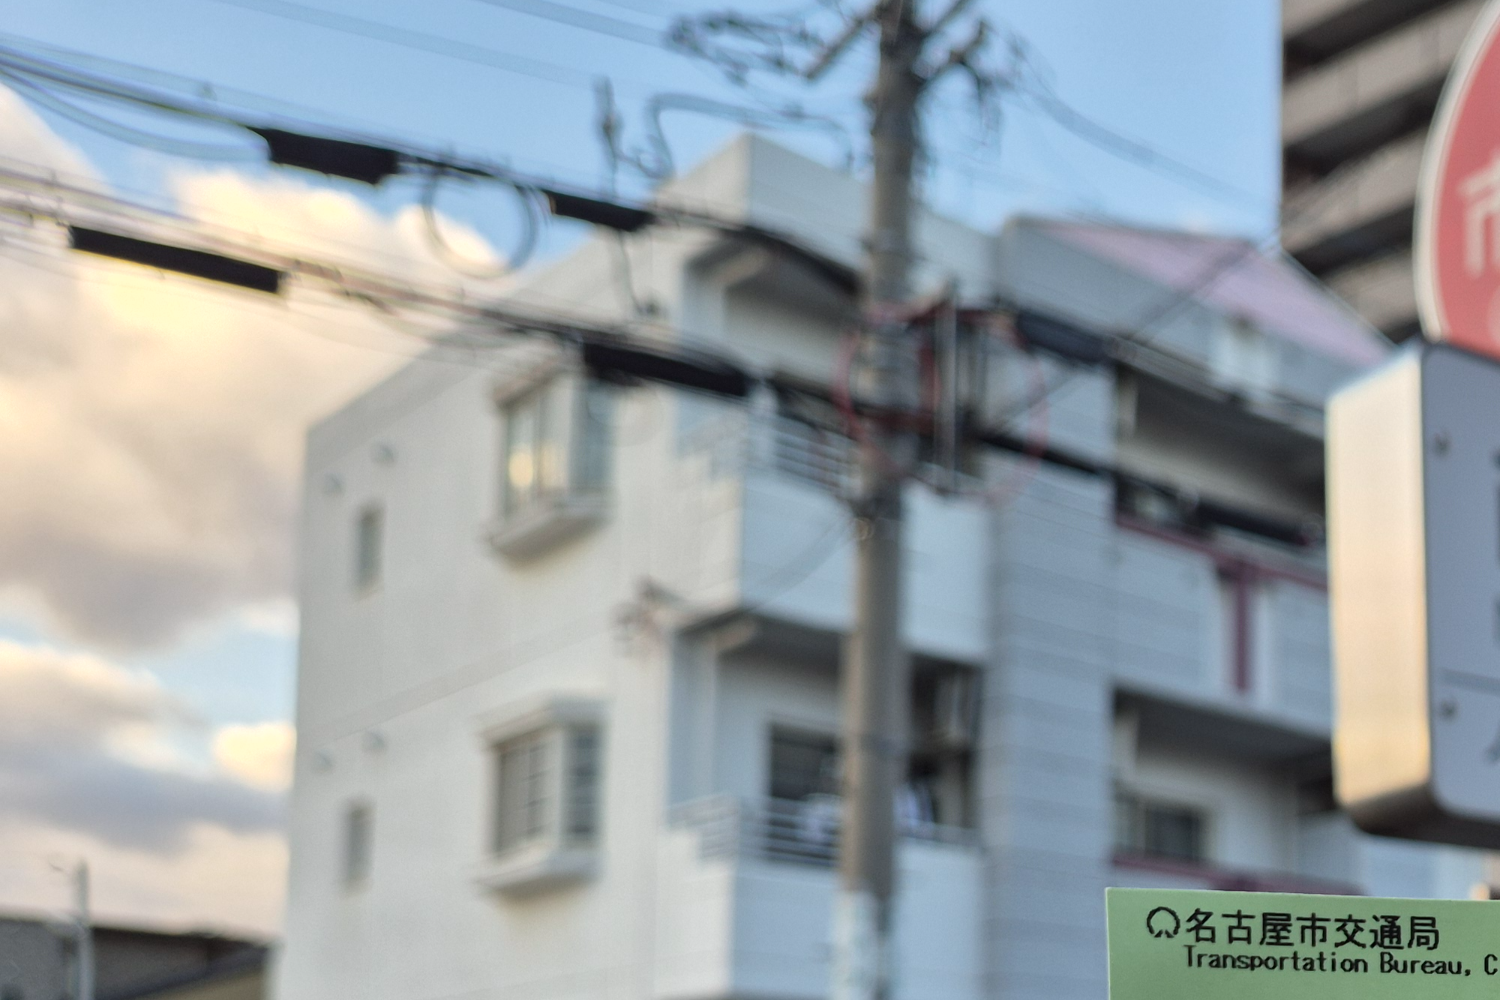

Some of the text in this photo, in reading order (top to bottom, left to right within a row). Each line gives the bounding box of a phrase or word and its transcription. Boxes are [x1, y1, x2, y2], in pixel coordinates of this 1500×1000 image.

[1184, 908, 1440, 952] 名古屋市交通局
[1184, 944, 1369, 973] Transportation
[1380, 952, 1471, 977] Bureau,
